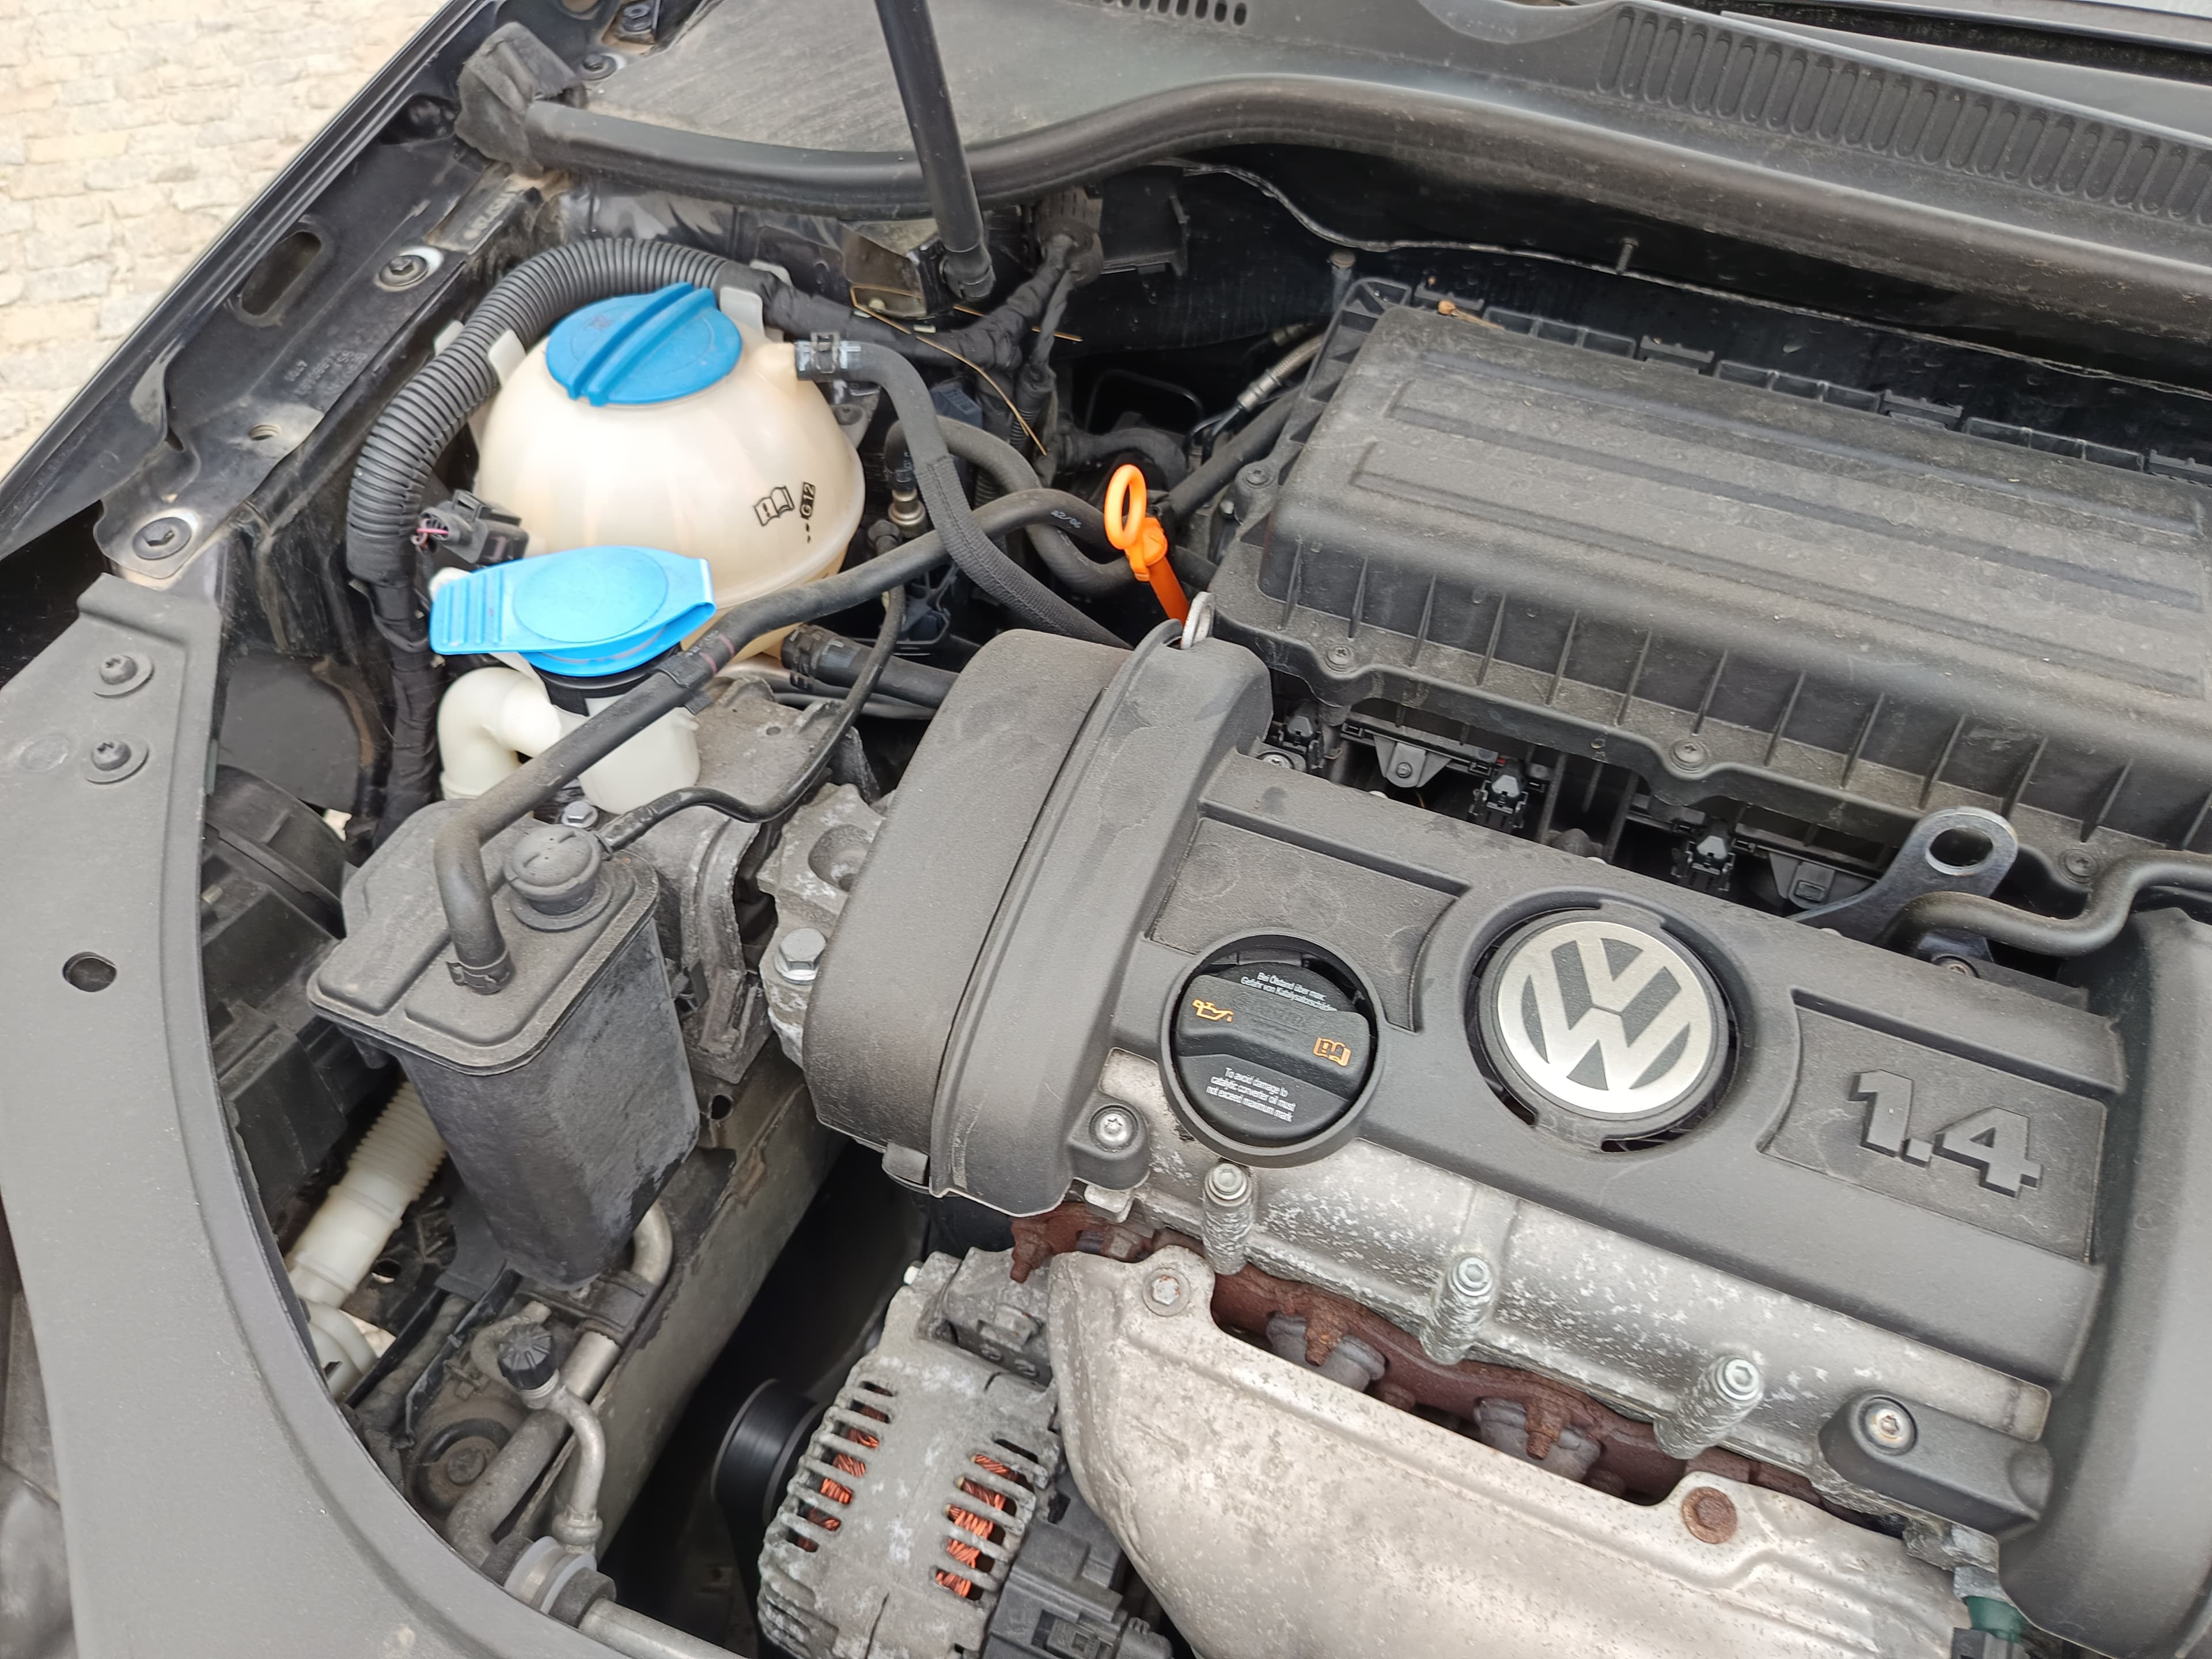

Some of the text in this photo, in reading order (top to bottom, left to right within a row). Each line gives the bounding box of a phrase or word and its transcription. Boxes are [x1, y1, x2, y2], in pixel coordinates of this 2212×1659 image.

[1240, 976, 1264, 989] Gefahr
[1263, 984, 1276, 993] von
[1257, 972, 1270, 982] Bei
[1210, 1076, 1296, 1112] catalytic converter oil must
[1225, 1067, 1289, 1097] To avoid damage to
[1206, 1086, 1294, 1123] not exceed maximum mark
[1848, 1069, 2043, 1199] 1.4
